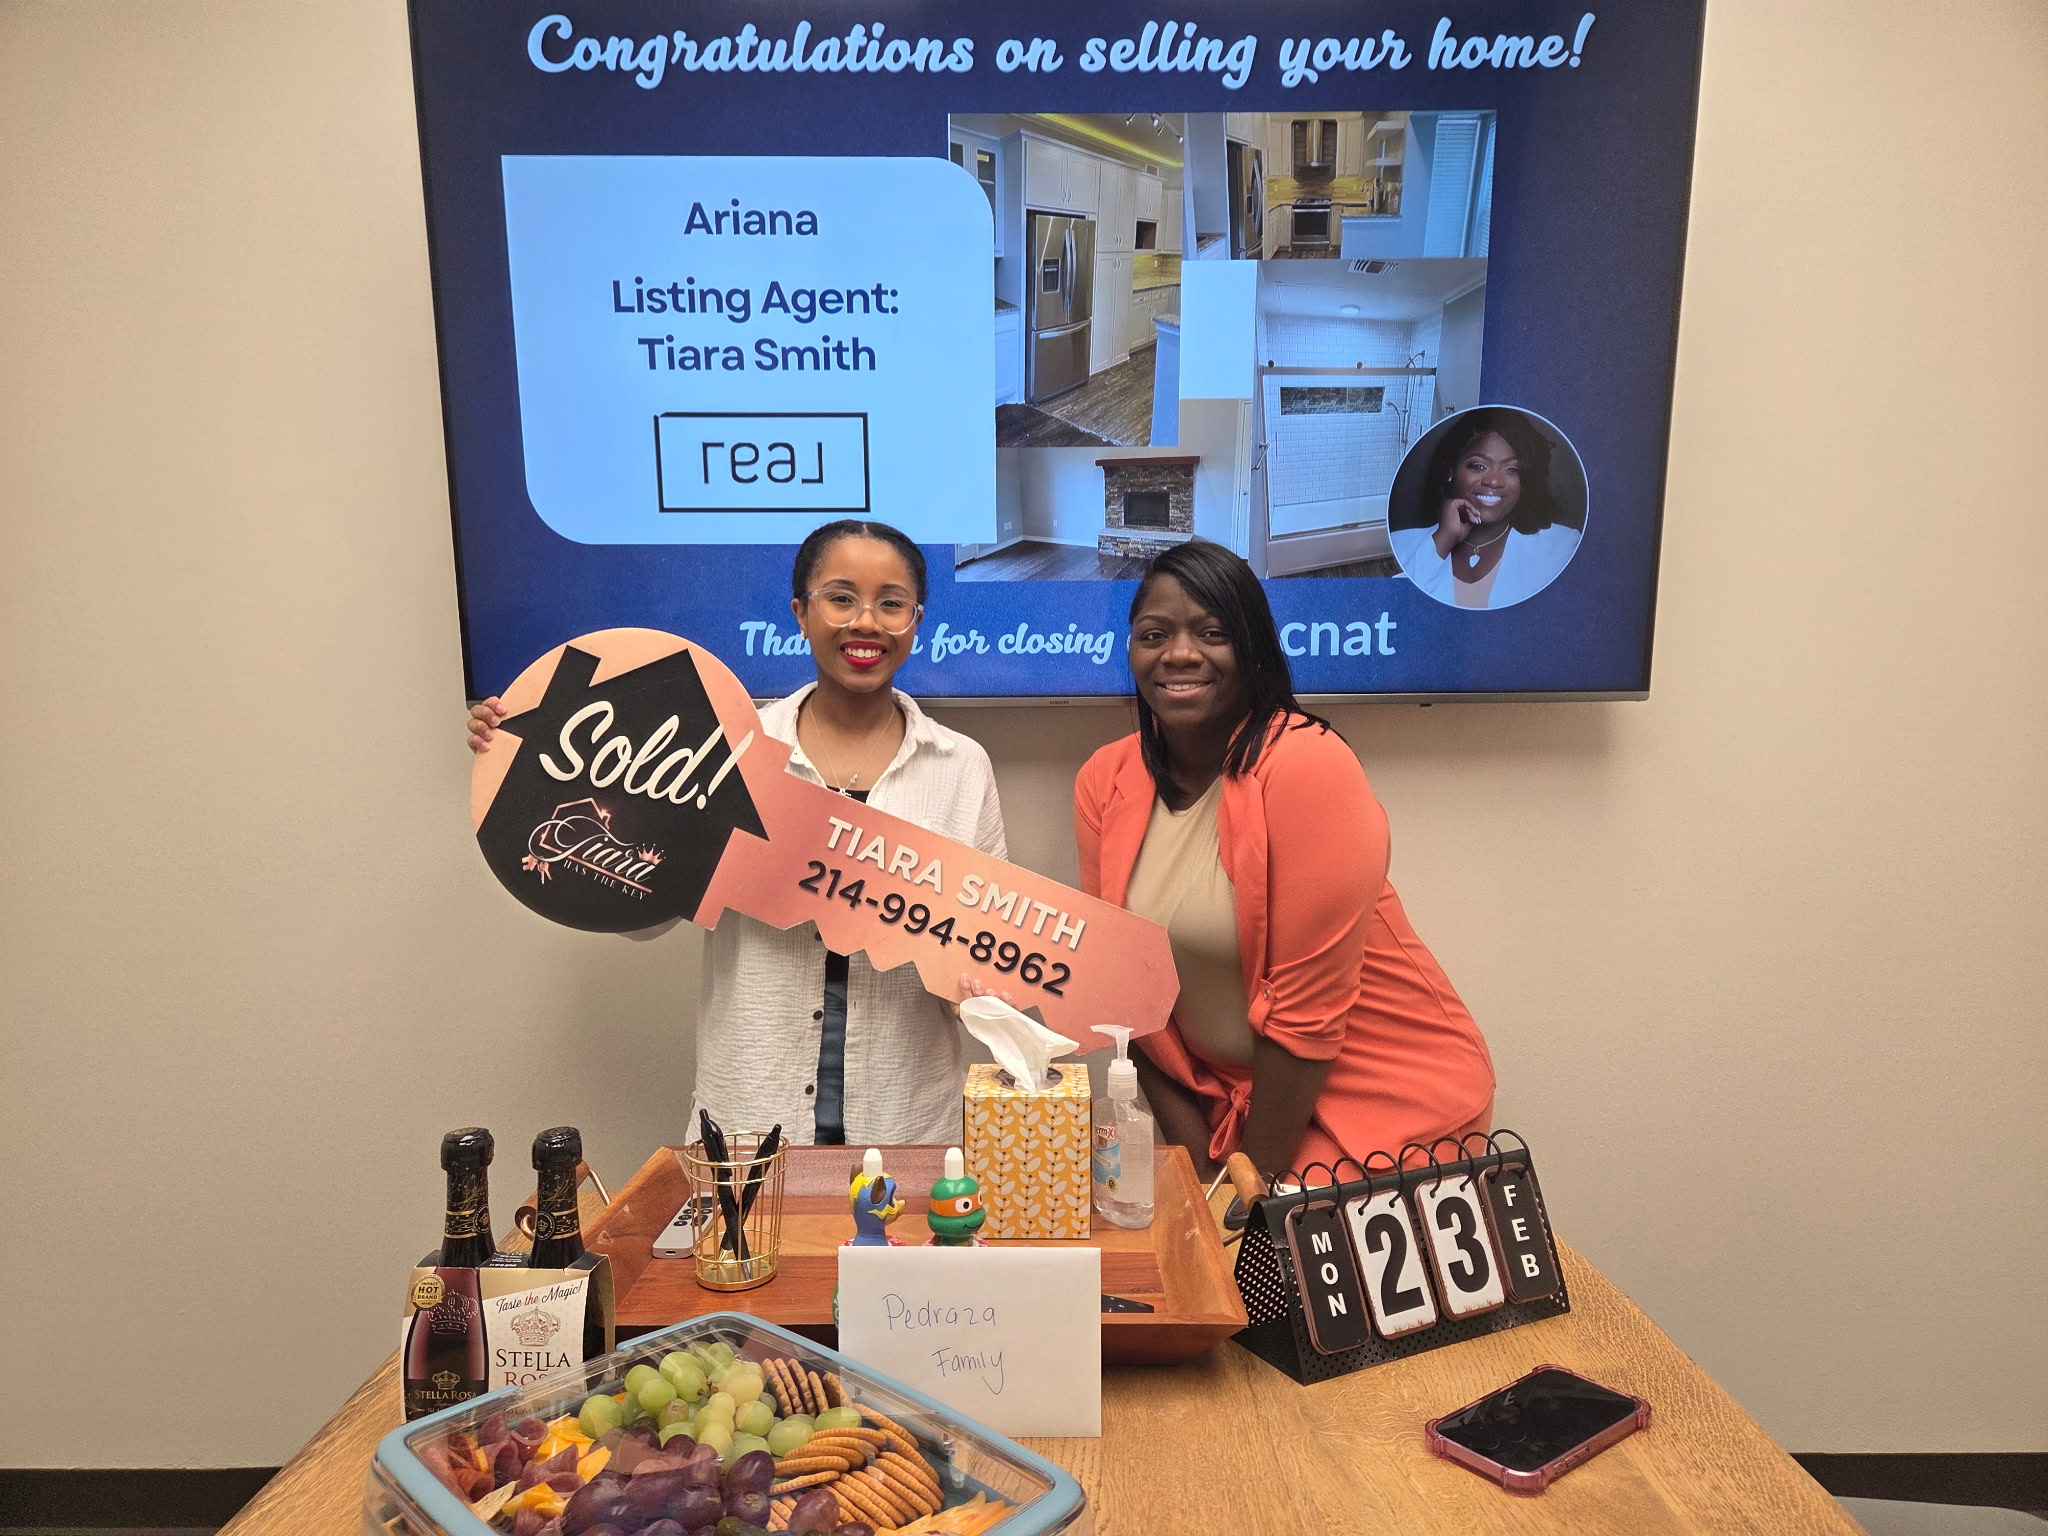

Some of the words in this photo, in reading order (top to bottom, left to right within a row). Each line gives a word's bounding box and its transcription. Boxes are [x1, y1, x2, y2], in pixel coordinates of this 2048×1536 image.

[527, 14, 974, 89] Congratulations
[996, 40, 1062, 73] on
[1079, 20, 1257, 89] selling
[1278, 35, 1412, 88] your
[1427, 13, 1595, 72] home!
[683, 199, 819, 237] Ariana
[611, 276, 752, 324] Listing
[761, 280, 899, 325] Agent:
[638, 336, 745, 372] Tiara
[754, 335, 877, 372] Smith
[701, 440, 824, 486] real
[740, 620, 811, 656] Tha
[931, 622, 990, 663] for
[997, 622, 1116, 665] closing
[539, 700, 754, 810] Sold!
[528, 815, 656, 883] Tiara
[563, 860, 587, 876] HAS
[593, 871, 616, 889] THE
[622, 885, 647, 900] KEY
[827, 816, 944, 894] TIARA
[956, 874, 1086, 950] SMITH
[799, 860, 1071, 996] 214-994-8962
[1311, 1231, 1348, 1318] MON
[1503, 1185, 1541, 1278] FEB
[418, 1286, 439, 1294] HOT
[496, 1297, 523, 1313] Taste
[524, 1292, 540, 1306] the
[541, 1280, 583, 1303] Magic!
[883, 1293, 997, 1331] Pedraza
[496, 1348, 571, 1372] STELLA
[932, 1348, 1004, 1395] Family
[415, 1390, 449, 1400] STELLA
